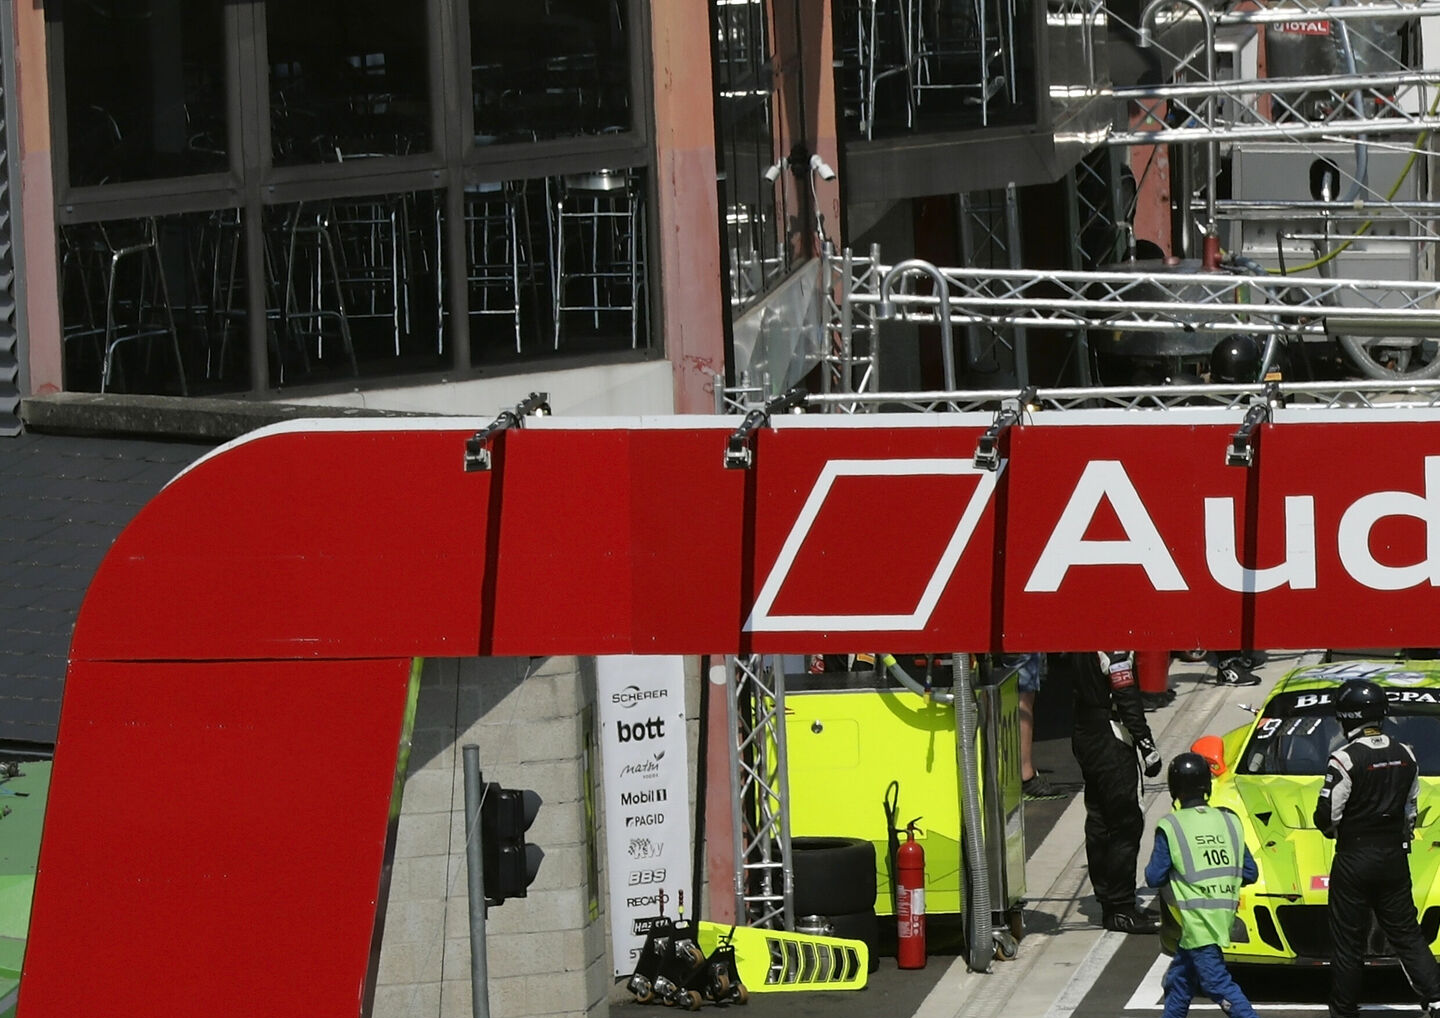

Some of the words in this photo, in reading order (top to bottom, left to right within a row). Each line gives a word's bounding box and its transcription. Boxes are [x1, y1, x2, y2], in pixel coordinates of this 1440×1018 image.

[611, 689, 668, 704] SCHERER
[616, 715, 666, 743] bott
[1256, 718, 1323, 739] 911
[620, 790, 654, 806] Mobil
[634, 813, 665, 827] PAGID
[1202, 848, 1230, 867] 106
[628, 868, 667, 887] BBS
